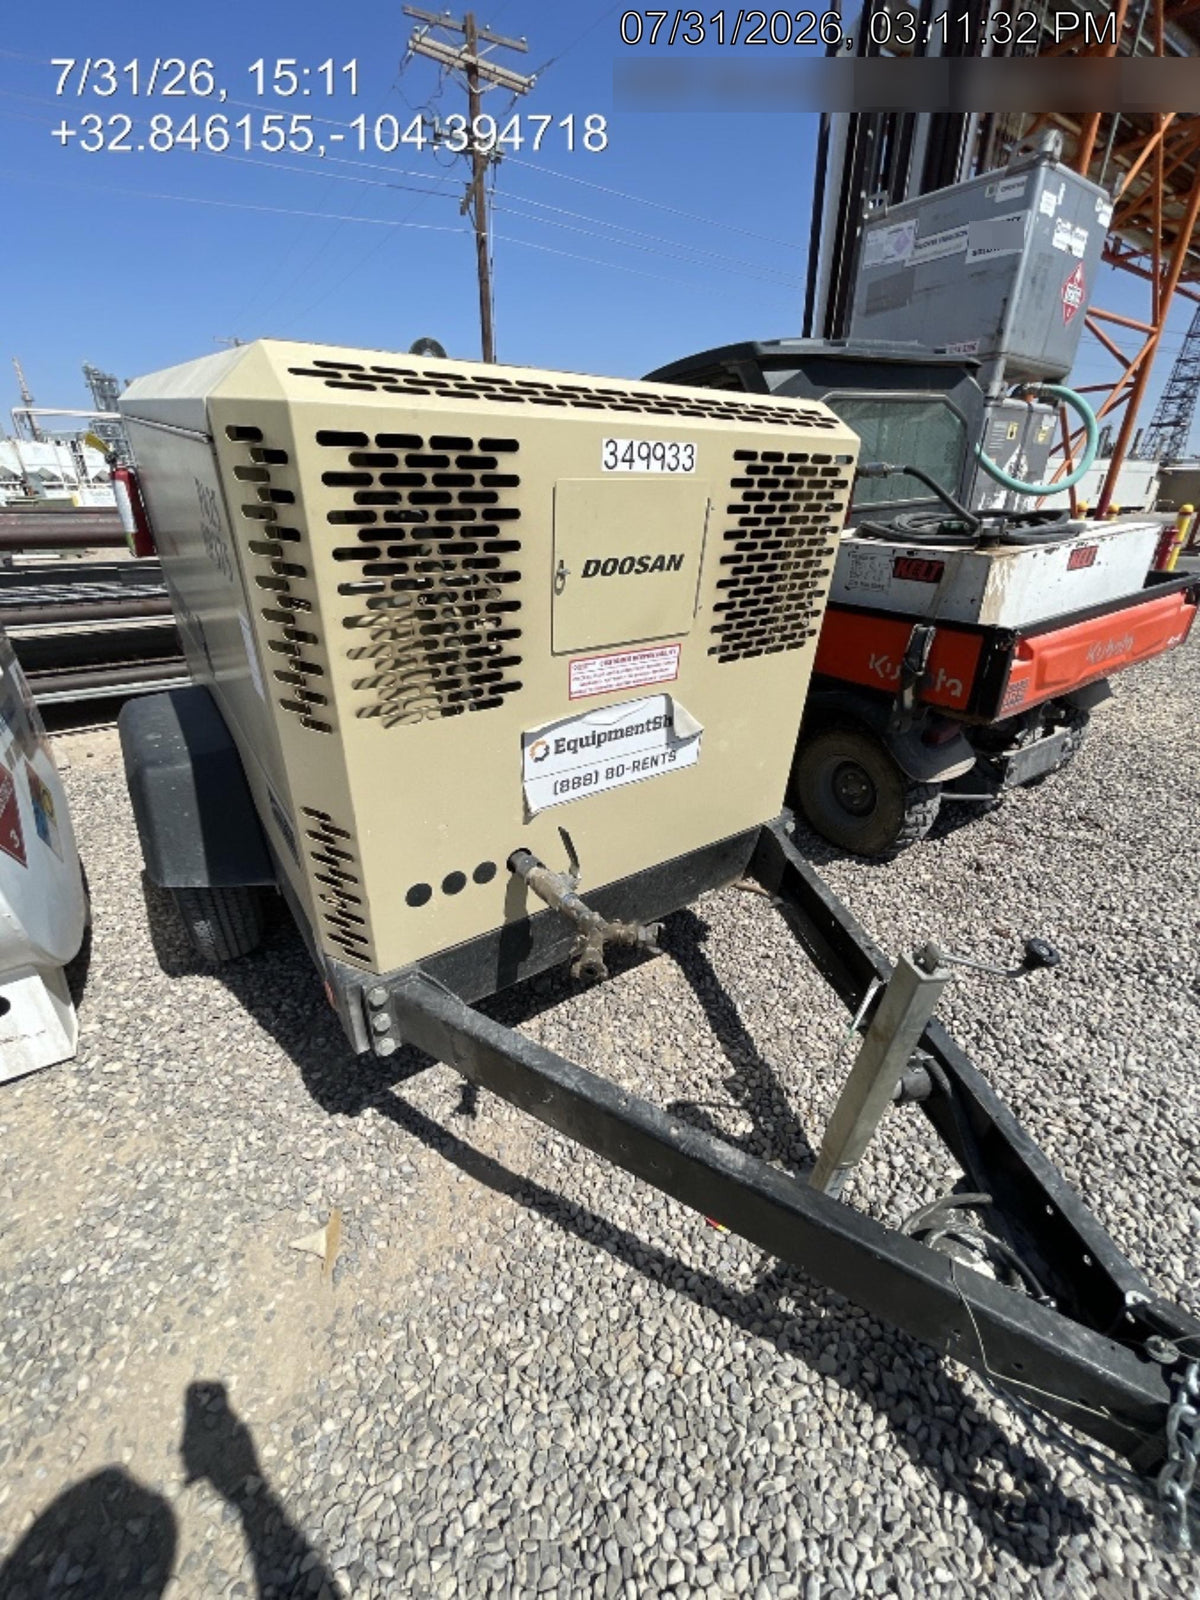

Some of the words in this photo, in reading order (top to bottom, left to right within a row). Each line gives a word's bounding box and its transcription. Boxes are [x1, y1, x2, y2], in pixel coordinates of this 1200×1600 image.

[604, 438, 695, 472] 349933
[581, 553, 685, 578] DOOSAN
[868, 653, 963, 697] Kuta
[552, 770, 600, 796] (888)
[604, 750, 678, 781] 80-RENTS
